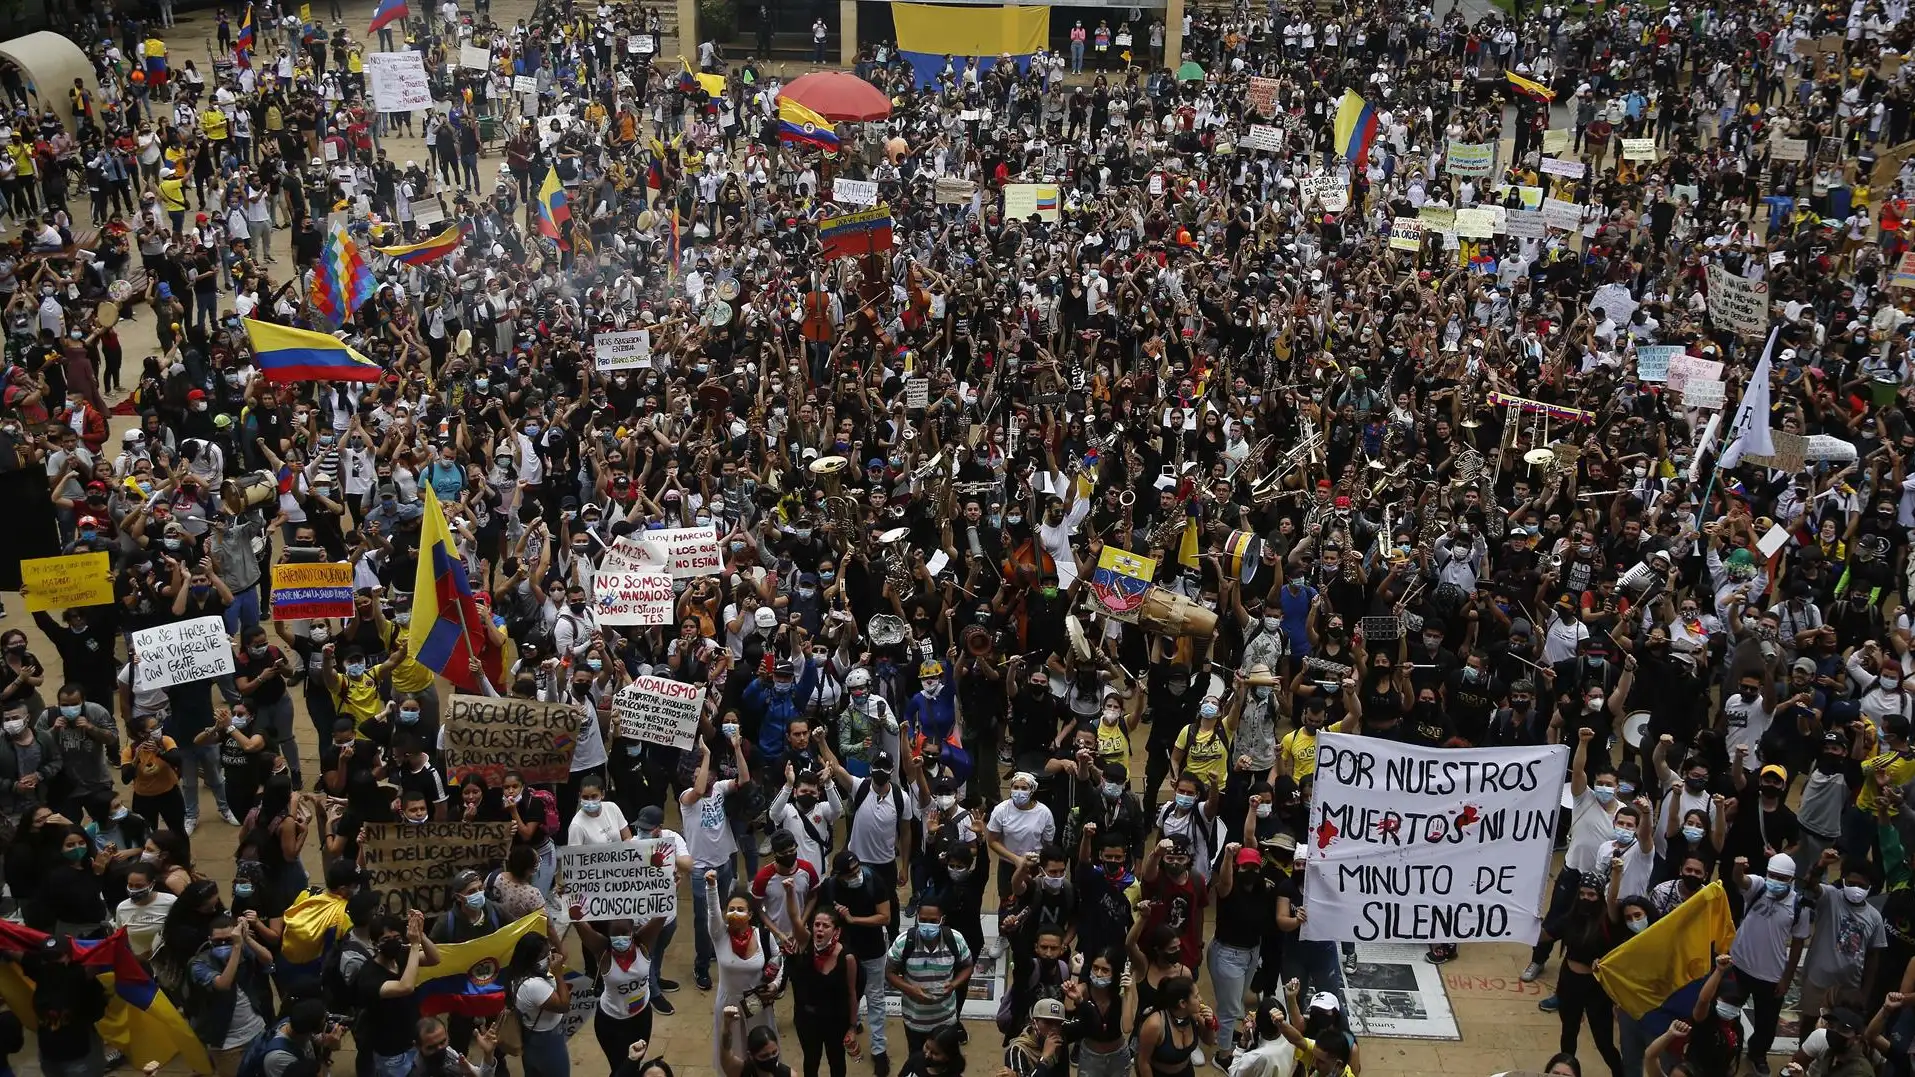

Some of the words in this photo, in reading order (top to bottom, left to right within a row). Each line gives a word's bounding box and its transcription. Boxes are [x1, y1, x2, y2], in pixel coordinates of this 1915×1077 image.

[835, 182, 873, 198] JUSTICIA
[1392, 230, 1399, 238] LA
[674, 531, 713, 542] MARCHO
[612, 543, 651, 560] ARRIBA
[677, 545, 697, 555] LOS
[700, 544, 717, 553] QUE
[609, 555, 625, 566] LOS
[629, 564, 640, 572] DE
[676, 560, 690, 568] NO
[597, 575, 619, 589] NO
[624, 574, 672, 589] SOMOS
[597, 601, 629, 615] SOMOS
[643, 614, 664, 624] TES
[137, 634, 152, 647] NO
[158, 628, 173, 642] SE
[179, 624, 205, 641] HACE
[210, 619, 223, 633] UN
[166, 634, 221, 657] DIFERENTE
[144, 664, 163, 682] CON
[167, 655, 195, 672] GENTE
[171, 658, 226, 683] INDIFERENTE
[628, 691, 661, 705] IMPORTAR
[662, 698, 697, 712] PRODUCTOS
[453, 700, 539, 728] DISCULPE
[543, 706, 576, 732] LAS
[644, 713, 679, 729] NUESTROS
[449, 727, 555, 751] MOLESTIAS
[1314, 745, 1375, 789] POR
[1385, 757, 1542, 795] NUESTROS
[1321, 801, 1465, 846] MUERTOS
[1478, 808, 1506, 843] NI
[1512, 810, 1556, 843] UN
[366, 825, 386, 841] NI
[396, 823, 505, 842] TERRORISTAS
[365, 849, 383, 864] NI
[563, 854, 574, 866] NI
[576, 849, 643, 866] TERRORISTA
[369, 867, 426, 885] SOMOS
[562, 869, 573, 880] NI
[577, 866, 665, 880] DELINCUENTES
[1338, 863, 1454, 896] MINUTO
[1475, 866, 1517, 895] DE
[564, 881, 600, 893] SOMOS
[604, 879, 671, 892] CIUDADANOS
[590, 893, 675, 917] CONSCIENTES
[1353, 901, 1512, 941] SILENCIO.
